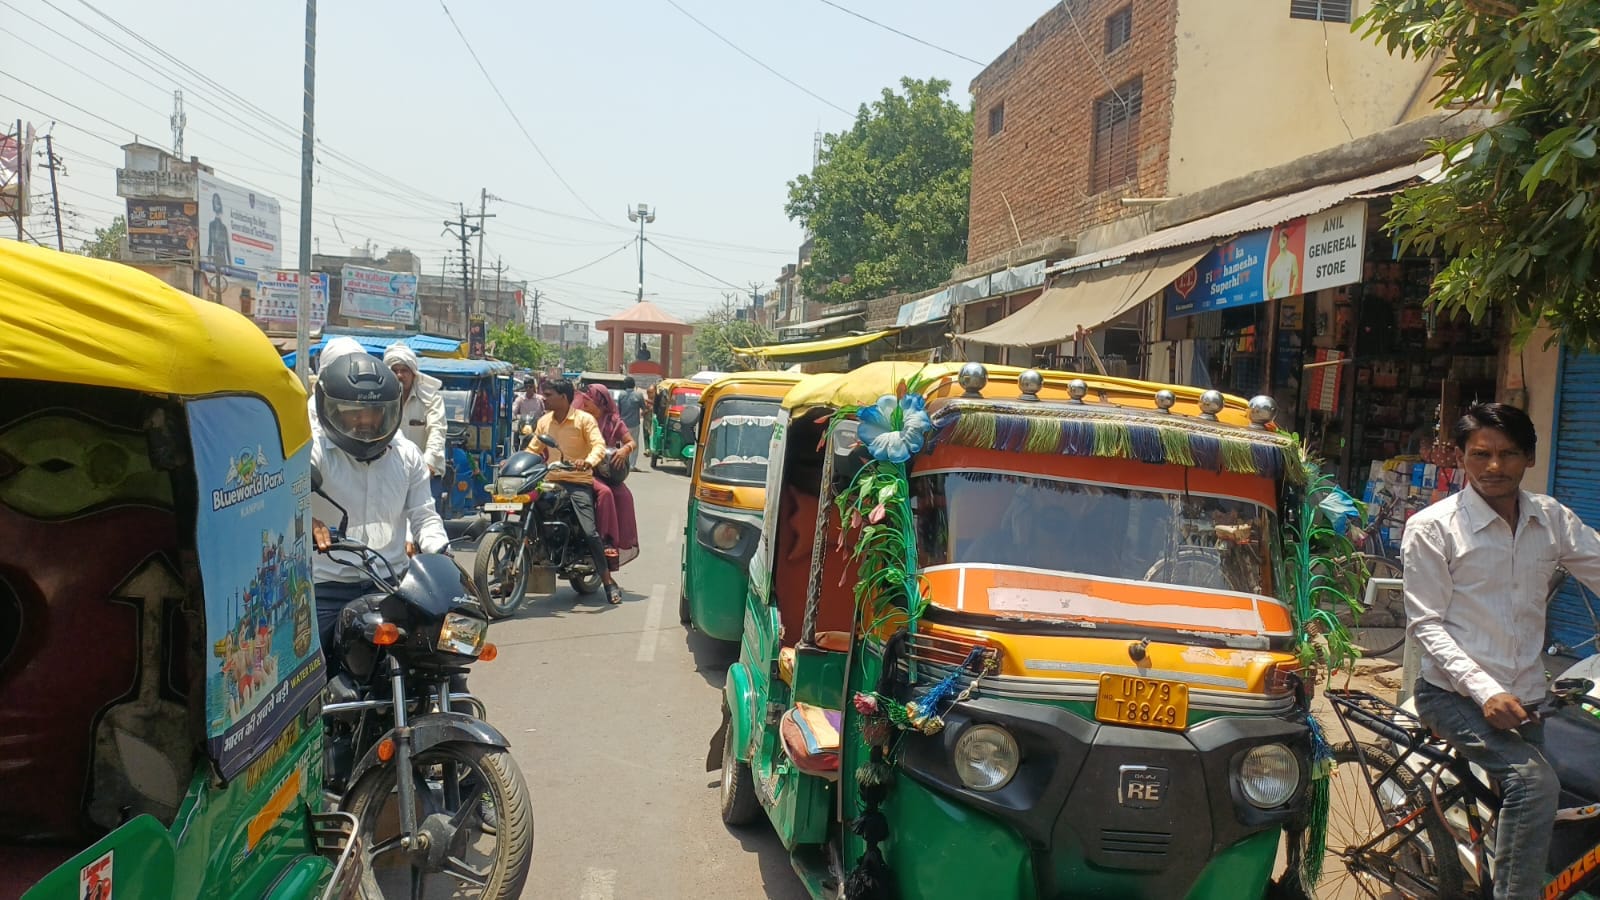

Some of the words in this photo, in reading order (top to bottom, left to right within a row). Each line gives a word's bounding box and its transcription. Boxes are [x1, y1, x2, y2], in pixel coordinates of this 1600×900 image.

[1322, 215, 1344, 233] ANIL
[1235, 247, 1244, 259] ka
[1308, 234, 1357, 258] GENEREAL
[1223, 254, 1258, 277] hamesha
[1316, 260, 1346, 278] STORE
[212, 475, 263, 511] Blueworld
[263, 468, 284, 493] Park
[1121, 677, 1170, 702] UP79
[224, 726, 244, 752] भारत
[244, 713, 256, 736] की
[256, 693, 275, 726] सबसे
[290, 666, 309, 689] WATER
[1114, 698, 1176, 725] T8849
[1127, 781, 1160, 801] RE
